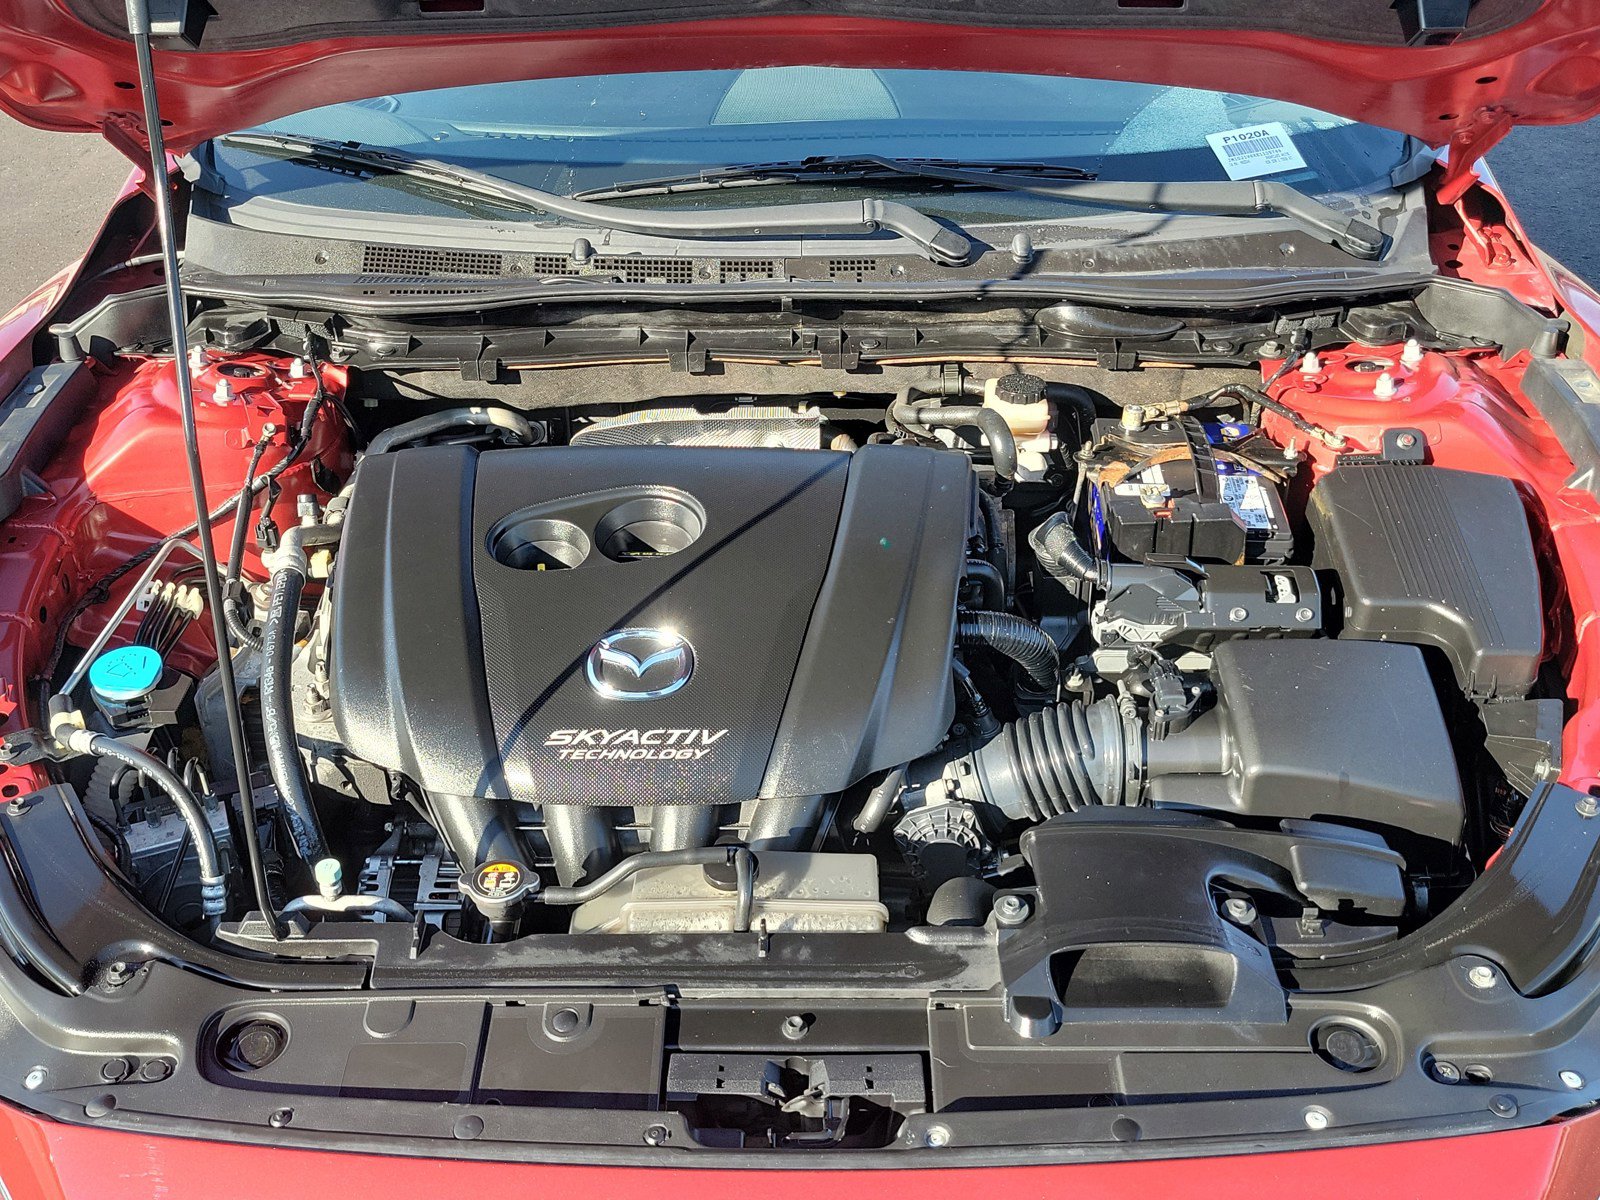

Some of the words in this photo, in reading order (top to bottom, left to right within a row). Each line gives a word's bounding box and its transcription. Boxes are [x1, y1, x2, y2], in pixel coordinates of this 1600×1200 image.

[1222, 129, 1270, 144] P1020A
[543, 729, 729, 746] SKYACTIV
[558, 749, 711, 760] TECHNOLOGY
